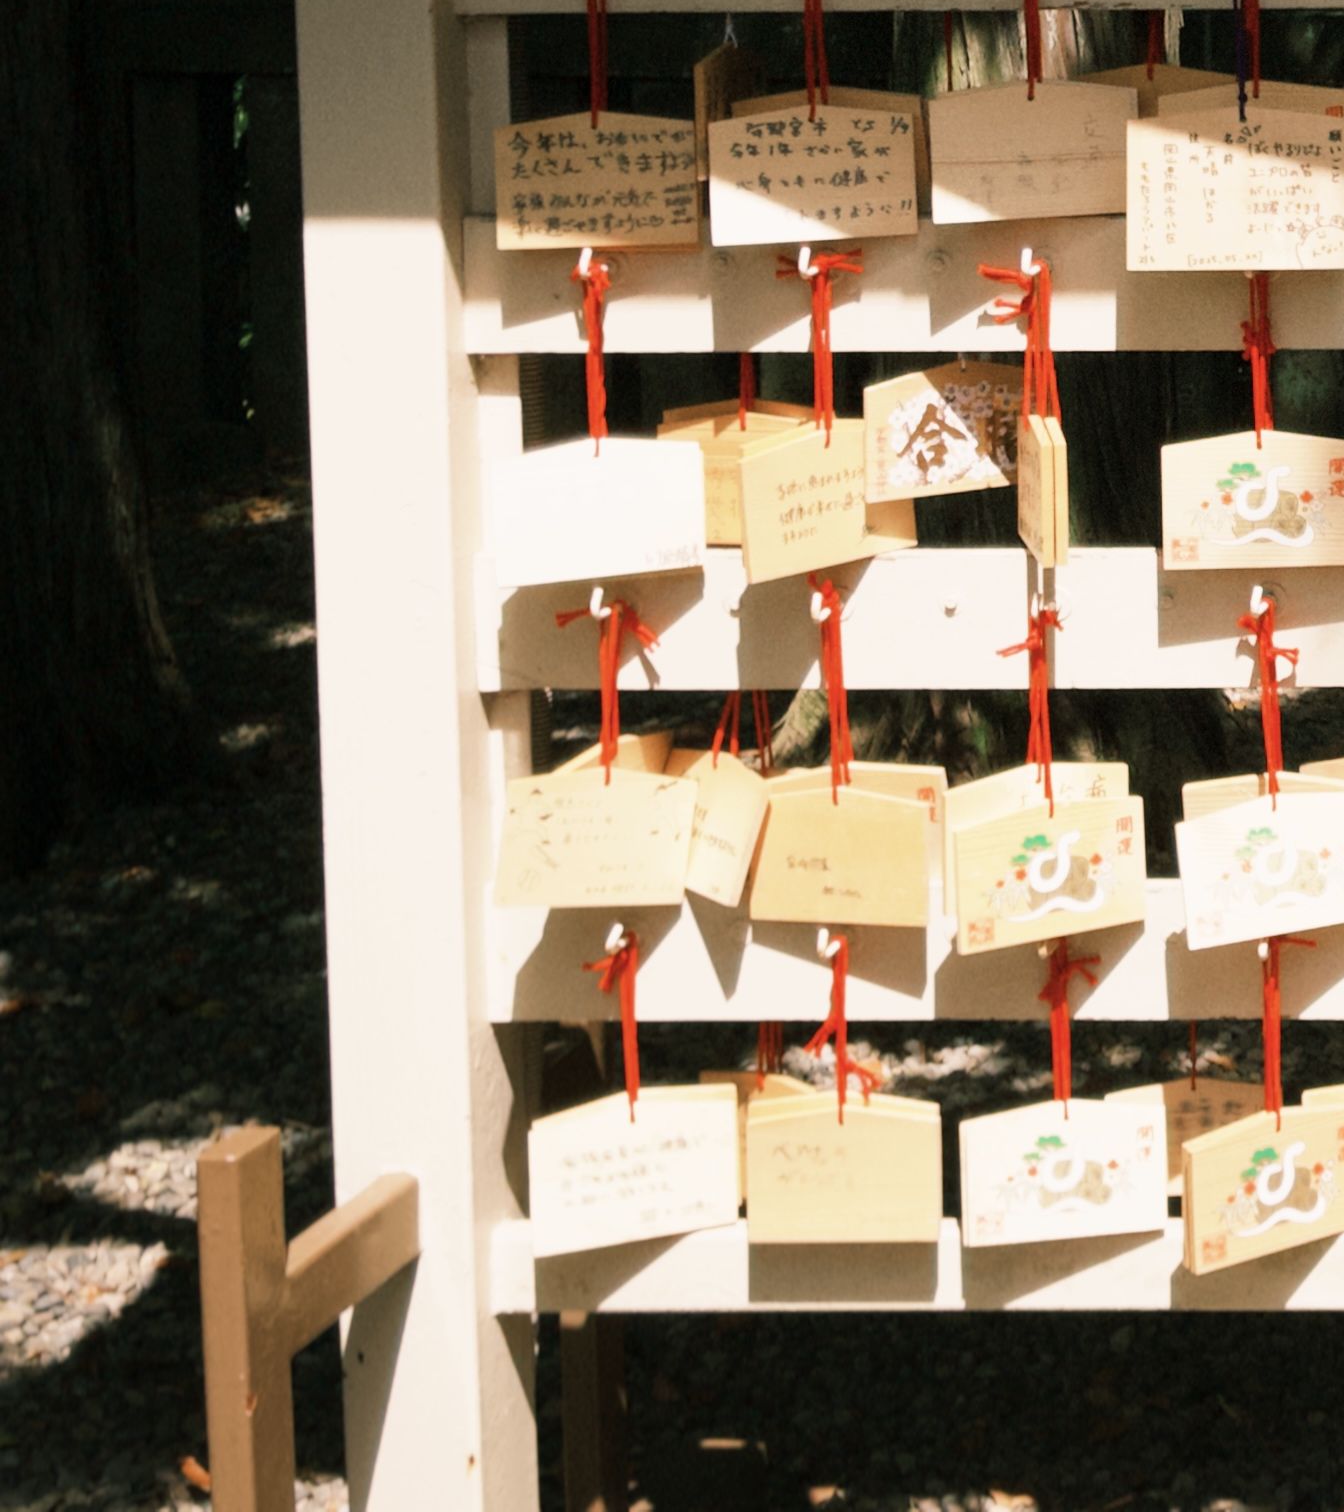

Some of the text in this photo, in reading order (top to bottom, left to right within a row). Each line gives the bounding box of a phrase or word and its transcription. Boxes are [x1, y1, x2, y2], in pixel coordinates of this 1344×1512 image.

[1328, 129, 1342, 183] 願いごと
[1115, 815, 1134, 856] 開運
